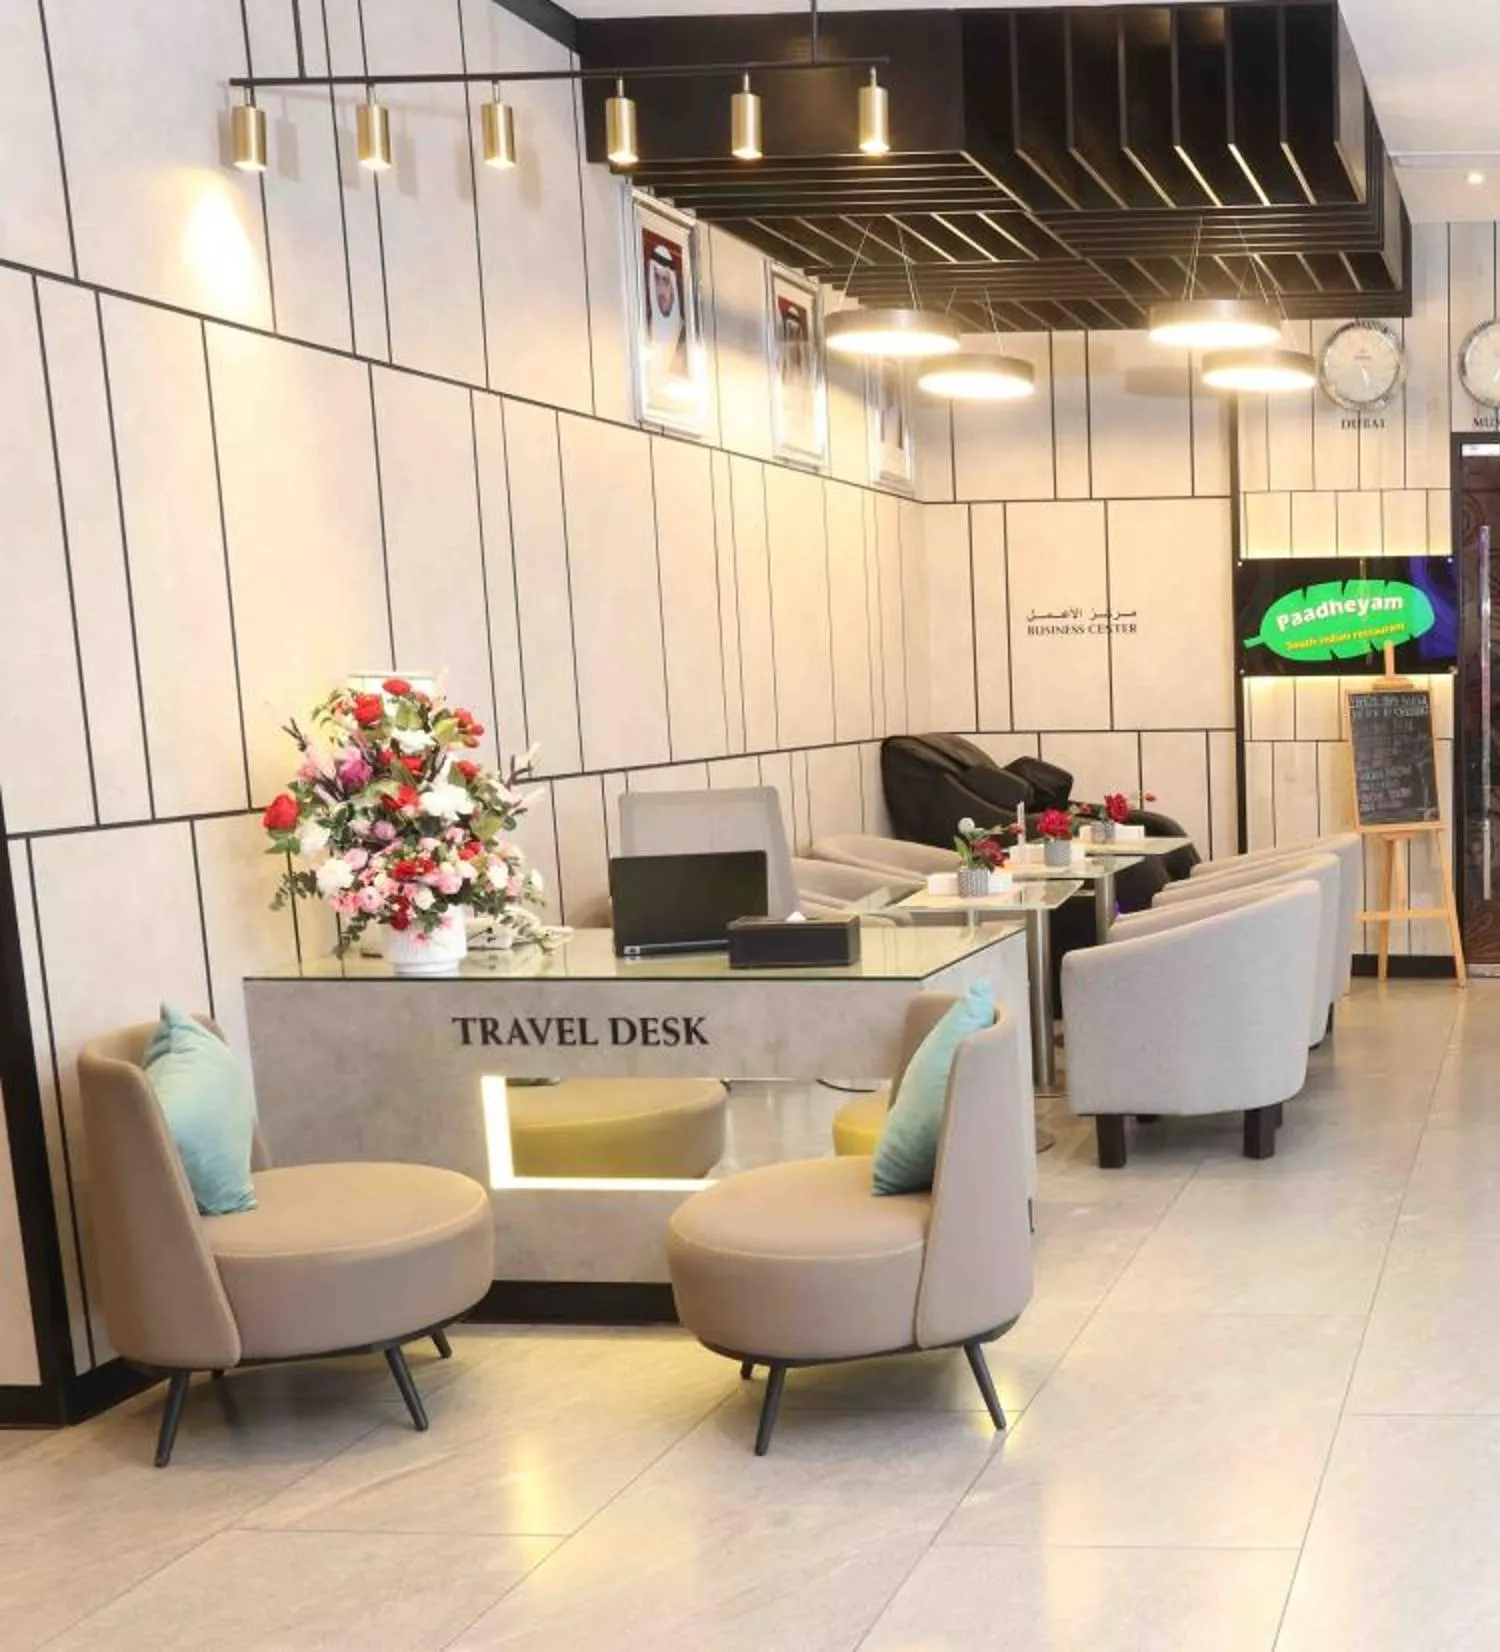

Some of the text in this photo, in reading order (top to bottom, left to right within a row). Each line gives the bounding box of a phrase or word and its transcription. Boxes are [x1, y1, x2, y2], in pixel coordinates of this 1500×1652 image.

[1341, 417, 1386, 429] DUBAI
[1275, 595, 1404, 632] Paadheyam
[1026, 623, 1137, 636] BUSINESS CENTER
[451, 1016, 710, 1046] TRAVEL DESK
